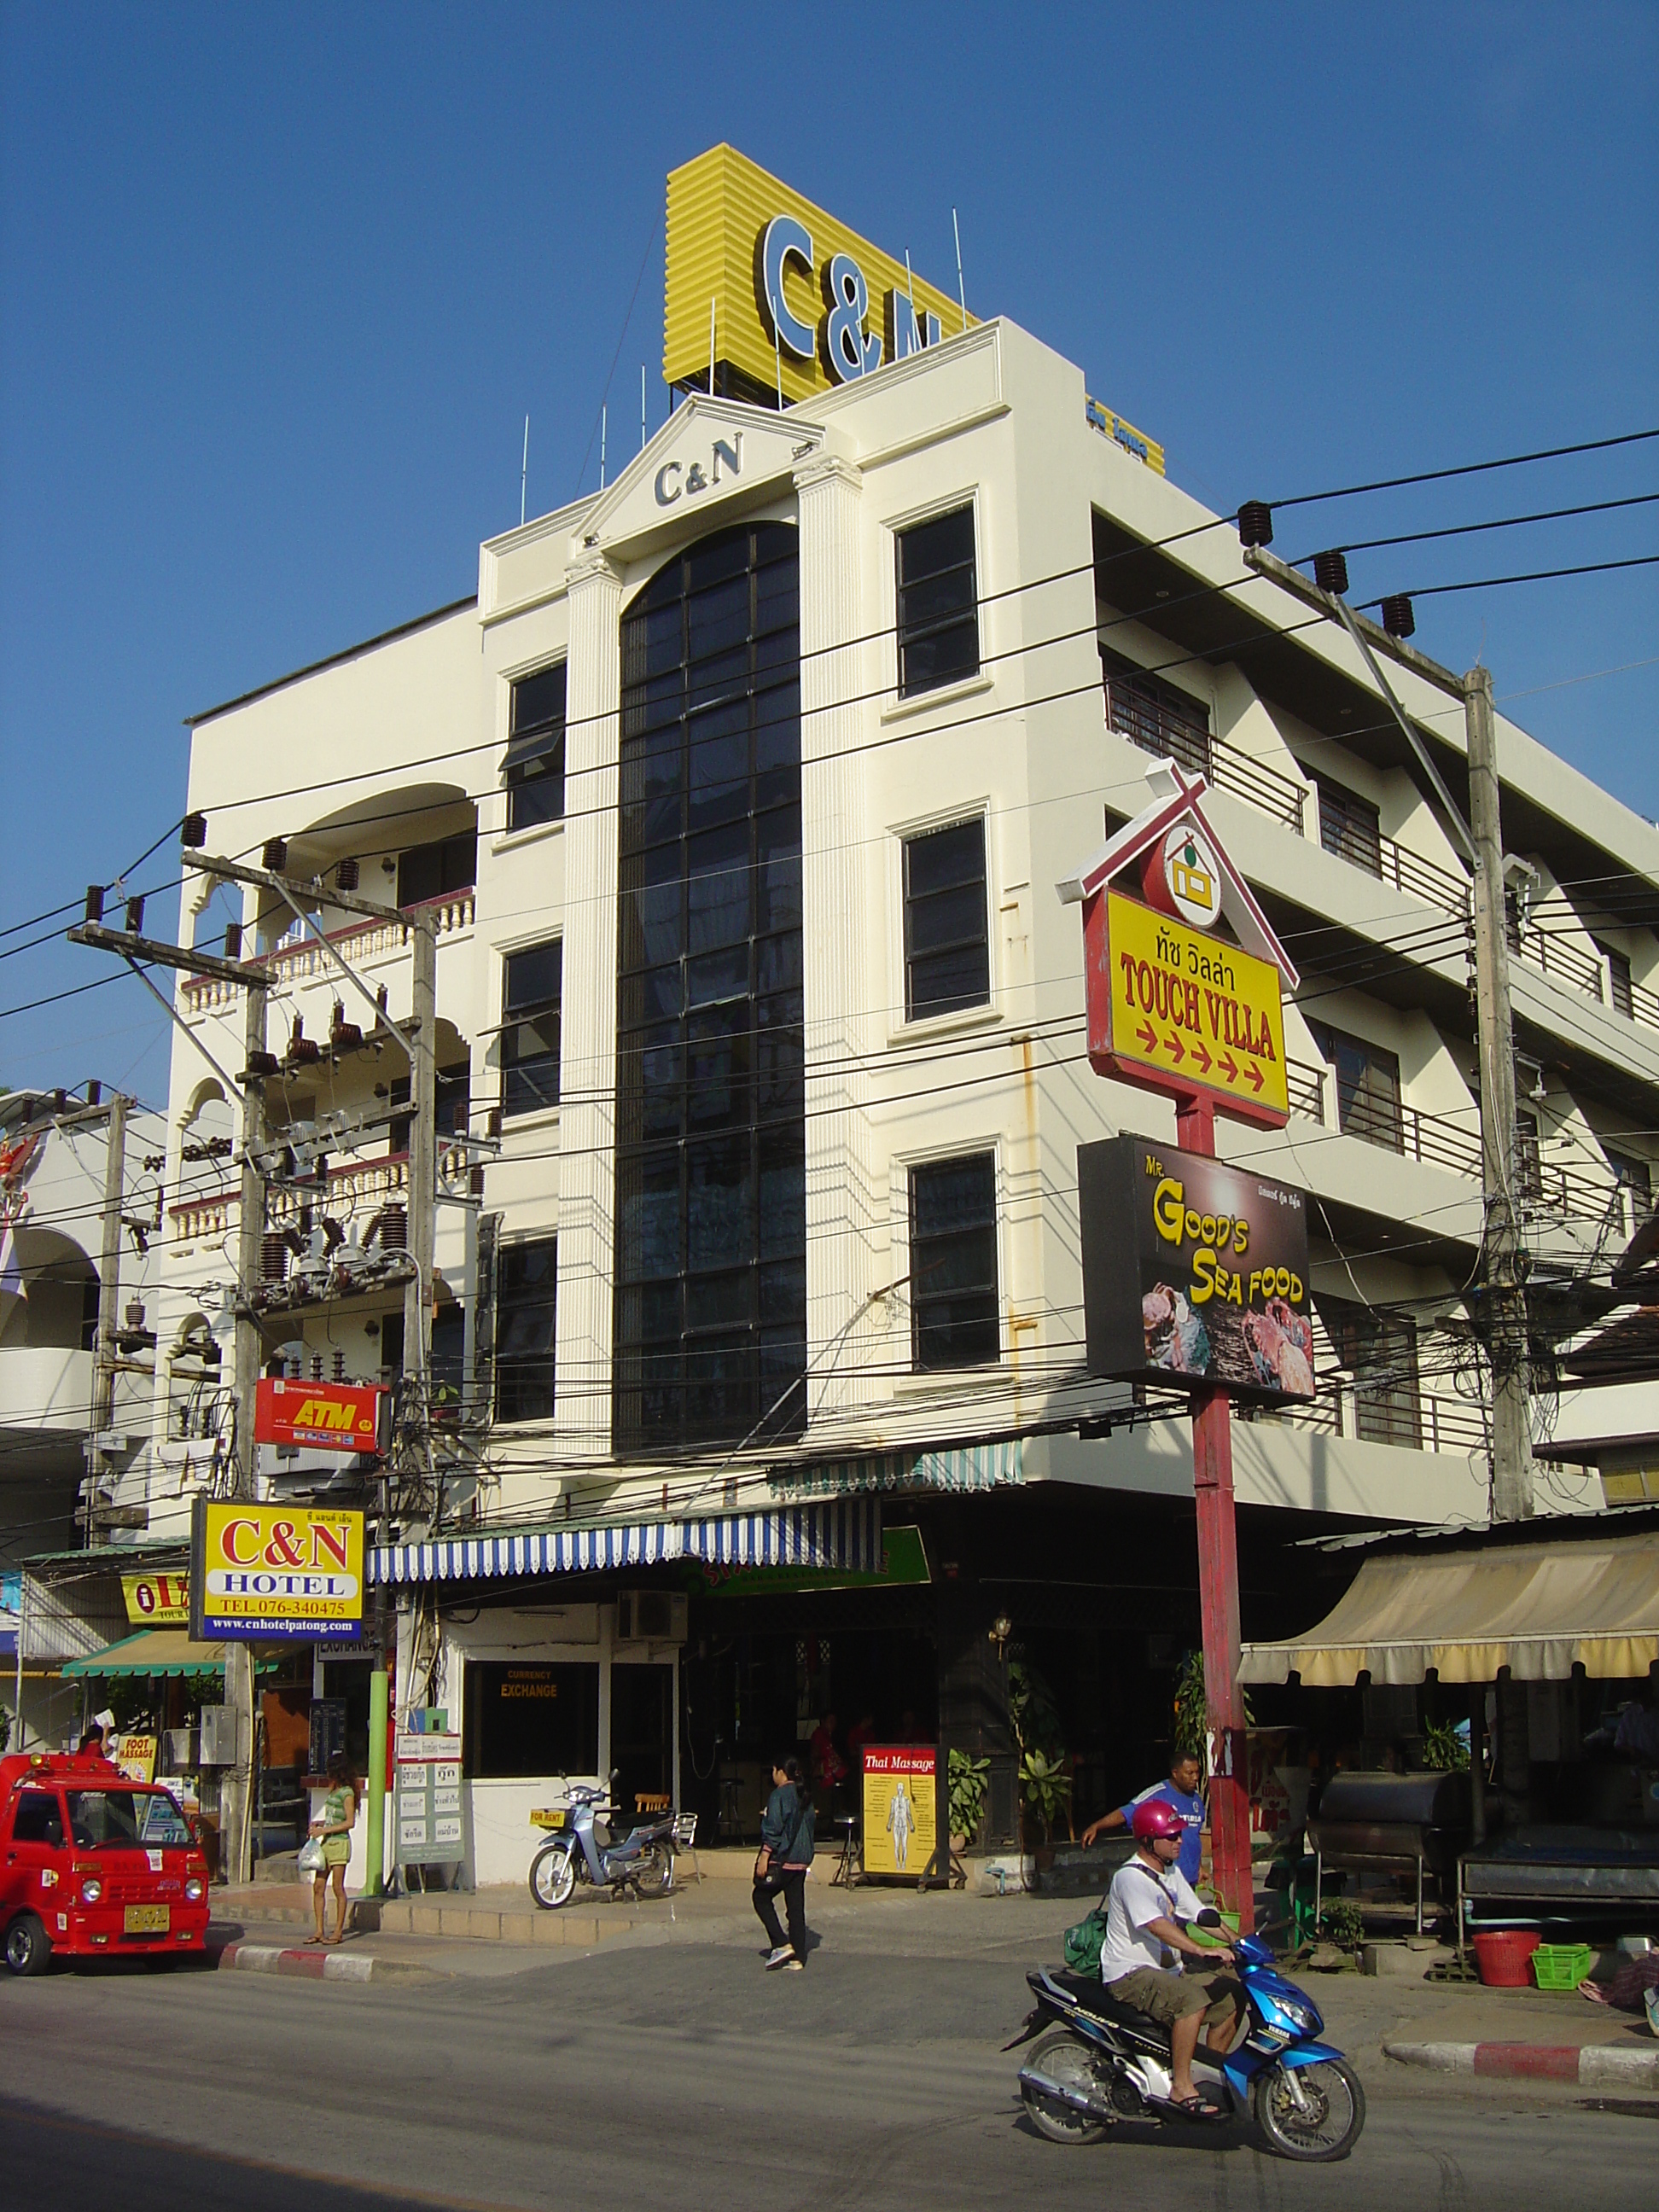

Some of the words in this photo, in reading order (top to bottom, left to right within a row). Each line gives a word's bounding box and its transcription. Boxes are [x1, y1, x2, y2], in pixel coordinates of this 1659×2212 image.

[760, 213, 942, 383] C&N
[655, 430, 744, 508] C&N
[1155, 926, 1181, 967] ทัช
[1188, 943, 1236, 992] วิลล่า
[1120, 952, 1202, 1035] TOUCH
[1203, 987, 1277, 1062] VILLA
[1249, 1266, 1303, 1304] FOOD
[293, 1399, 357, 1430] ATM
[220, 1517, 351, 1570] C&N
[223, 1573, 346, 1596] HOTEL
[159, 1610, 183, 1620] TOUR
[259, 1600, 345, 1615] 076-340475
[212, 1618, 353, 1633] www.cnhotelpatong.com
[507, 1670, 551, 1679] CURRENCY
[501, 1684, 557, 1697] EXCHANGE
[126, 1738, 149, 1749] FOOT
[118, 1749, 154, 1760] MASSAGE
[865, 1755, 888, 1769] Thai
[891, 1755, 934, 1773] Massage
[531, 1812, 543, 1821] FOR
[544, 1813, 561, 1822] RENT
